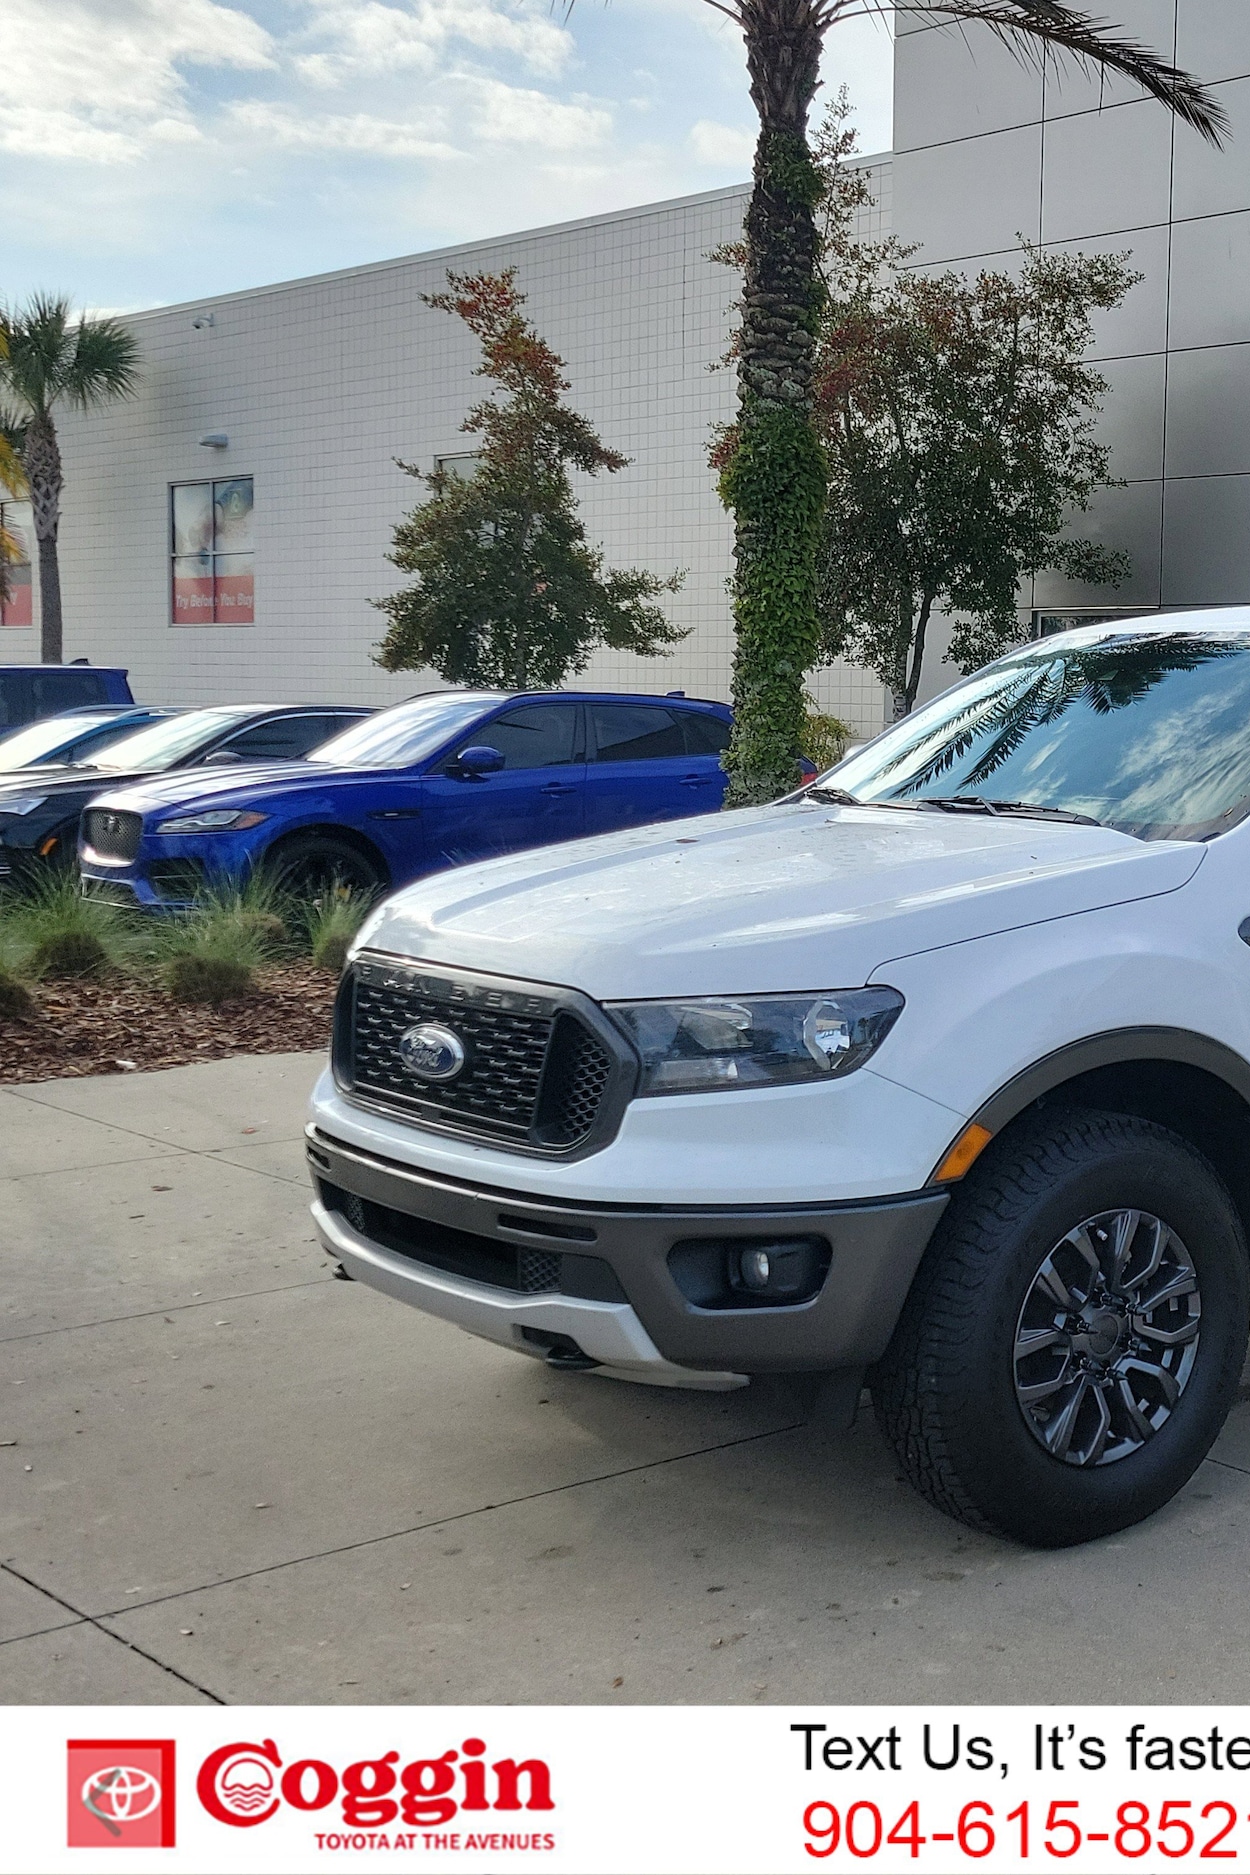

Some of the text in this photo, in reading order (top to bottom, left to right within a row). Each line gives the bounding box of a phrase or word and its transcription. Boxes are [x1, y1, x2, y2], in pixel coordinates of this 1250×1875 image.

[175, 593, 189, 609] Try
[220, 592, 235, 607] You
[237, 592, 253, 608] Buy
[404, 1033, 447, 1069] Ford
